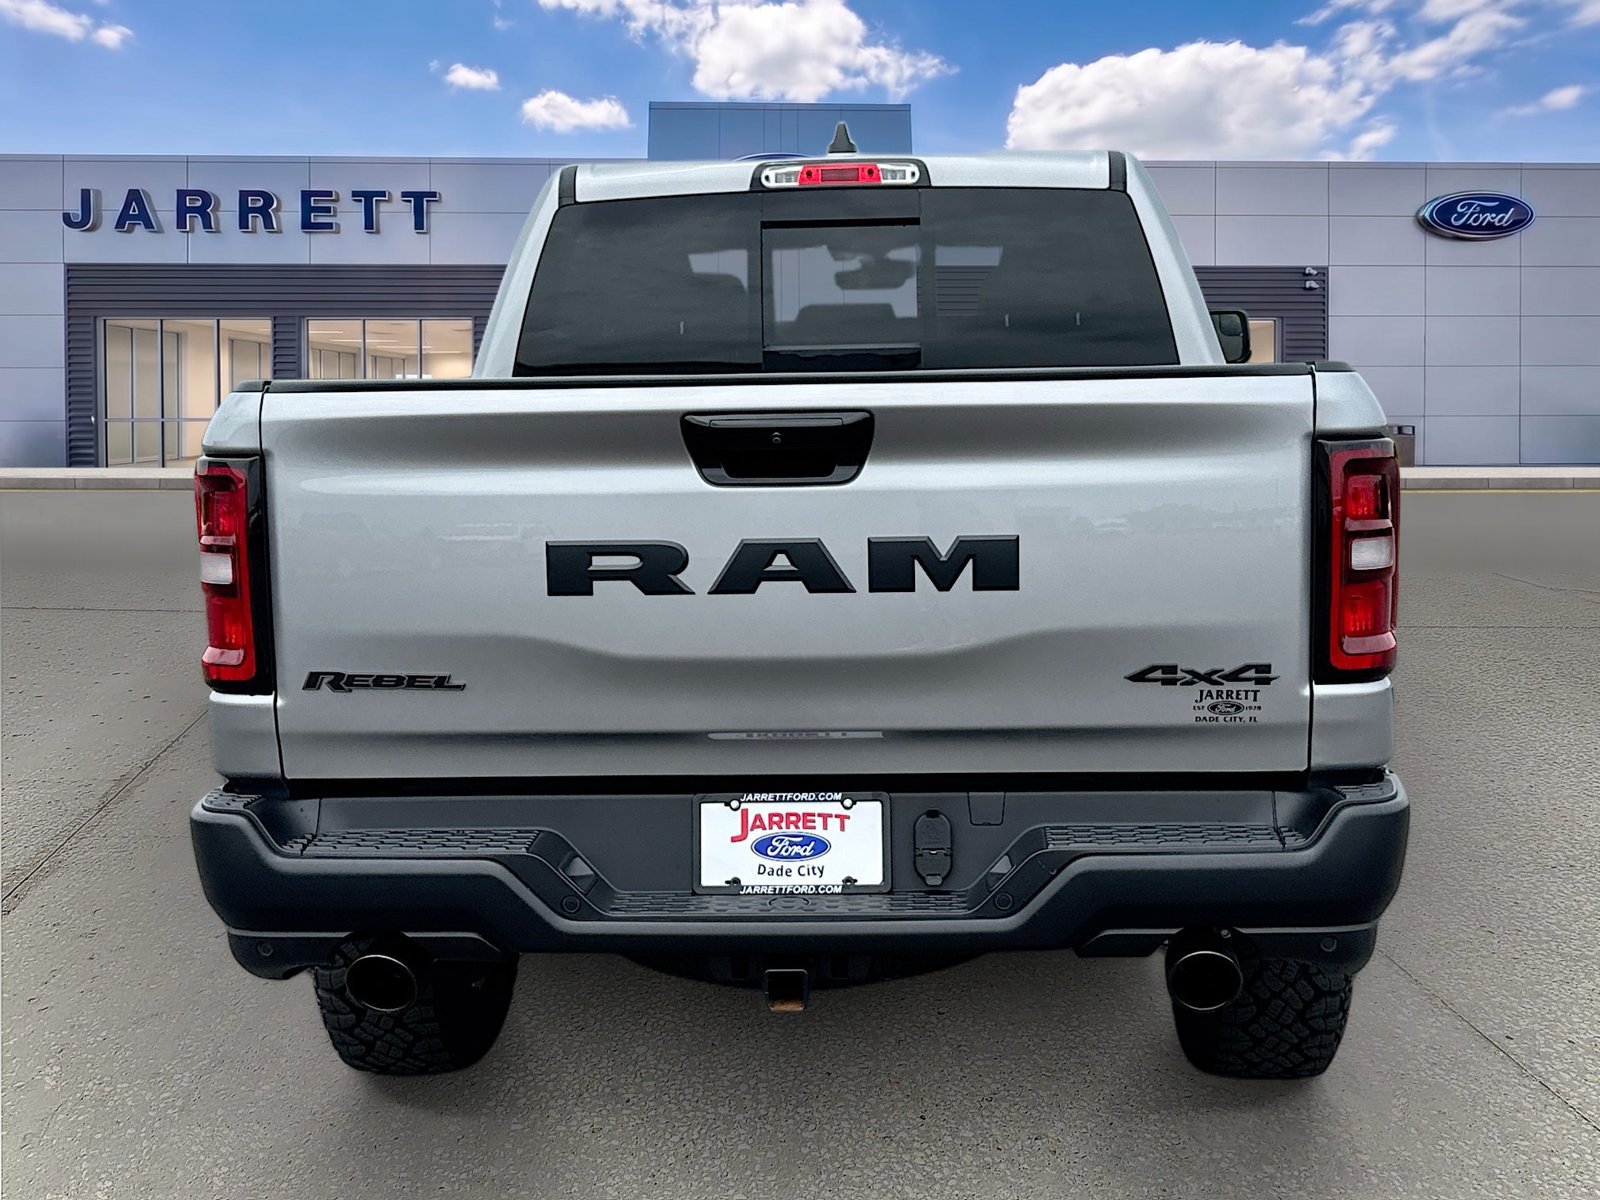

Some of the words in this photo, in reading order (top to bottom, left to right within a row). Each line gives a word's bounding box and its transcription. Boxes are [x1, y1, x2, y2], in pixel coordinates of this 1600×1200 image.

[62, 188, 440, 233] JARRETT
[1450, 199, 1515, 228] Ford
[545, 534, 1020, 597] RAM
[302, 671, 467, 693] REBEL
[1195, 689, 1261, 704] JARRETT
[740, 792, 842, 802] JARRETTFORD.COM
[730, 807, 851, 843] JARRETT
[766, 833, 816, 857] Ford
[757, 863, 793, 877] Dade
[797, 864, 825, 879] City
[739, 884, 843, 895] JARRETTFORD.COM
